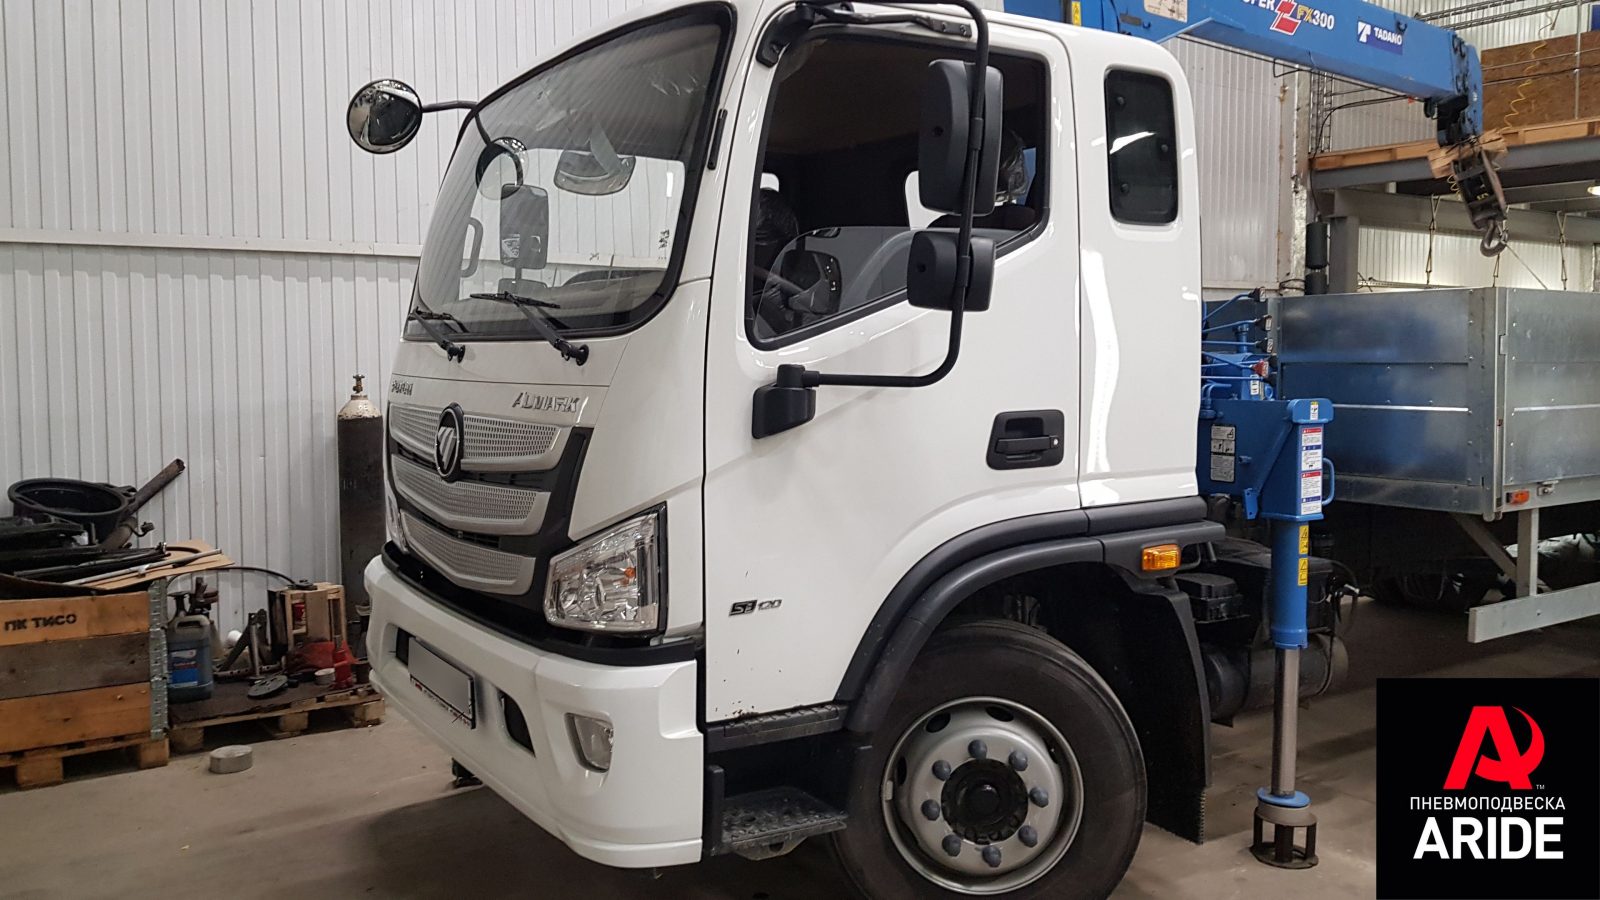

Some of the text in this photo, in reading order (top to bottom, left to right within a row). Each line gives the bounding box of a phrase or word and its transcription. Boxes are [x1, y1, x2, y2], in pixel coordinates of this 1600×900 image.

[1373, 27, 1403, 46] TADANO
[4, 613, 77, 631] ПК ТИСО
